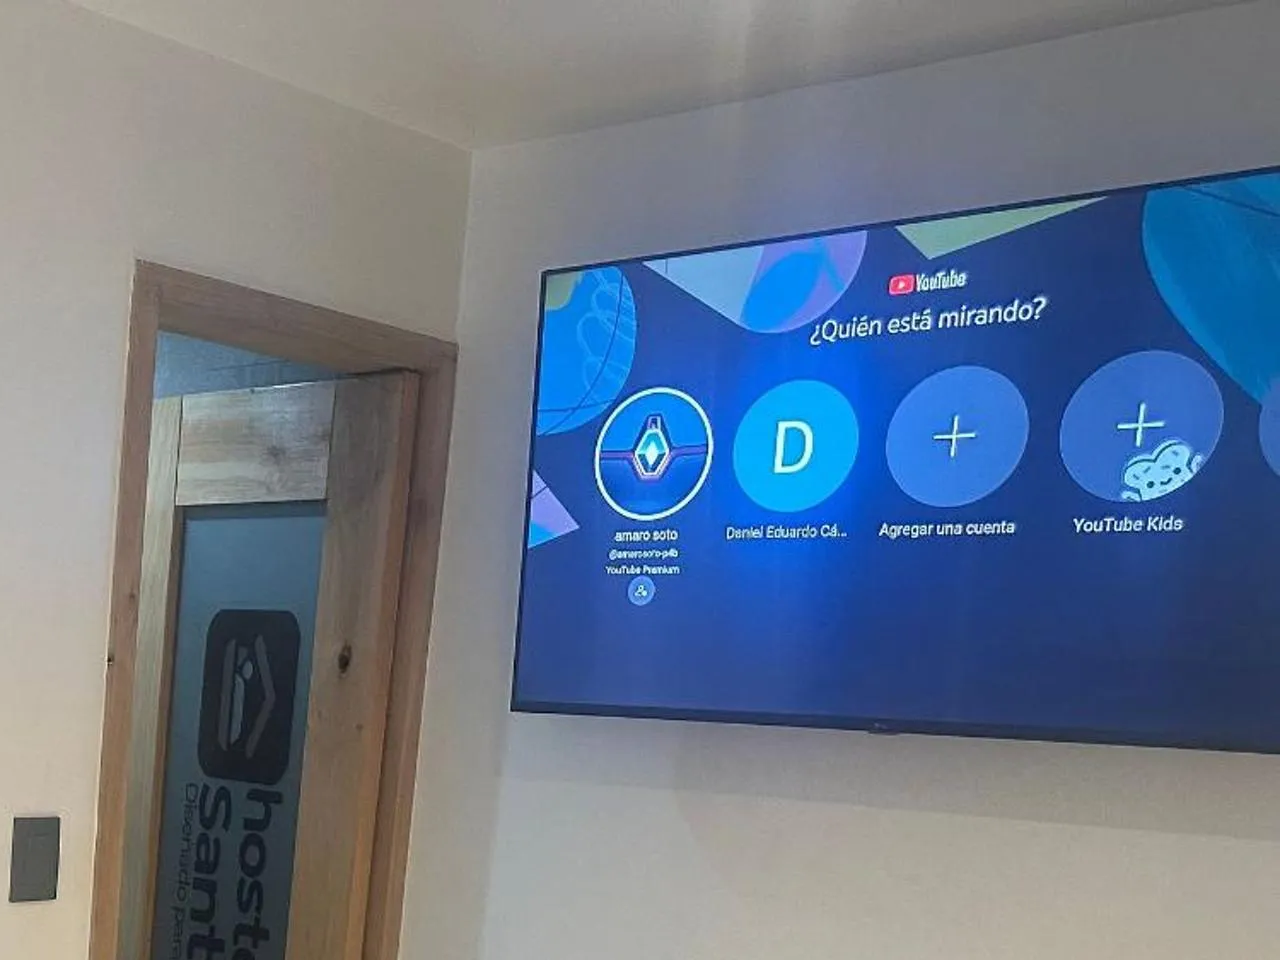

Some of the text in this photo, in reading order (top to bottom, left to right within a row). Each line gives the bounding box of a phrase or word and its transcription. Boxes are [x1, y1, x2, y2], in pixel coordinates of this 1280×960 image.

[916, 270, 967, 292] YouTube
[810, 296, 1047, 345] ¿Quién está mirando?
[773, 420, 814, 474] D
[726, 525, 763, 540] Daniel
[766, 525, 817, 539] Eduardo
[879, 521, 1015, 540] Agregar una cuenta
[1073, 515, 1184, 533] YouTube Kids
[614, 528, 679, 542] amaro soto
[605, 564, 681, 575] YouTube Premium
